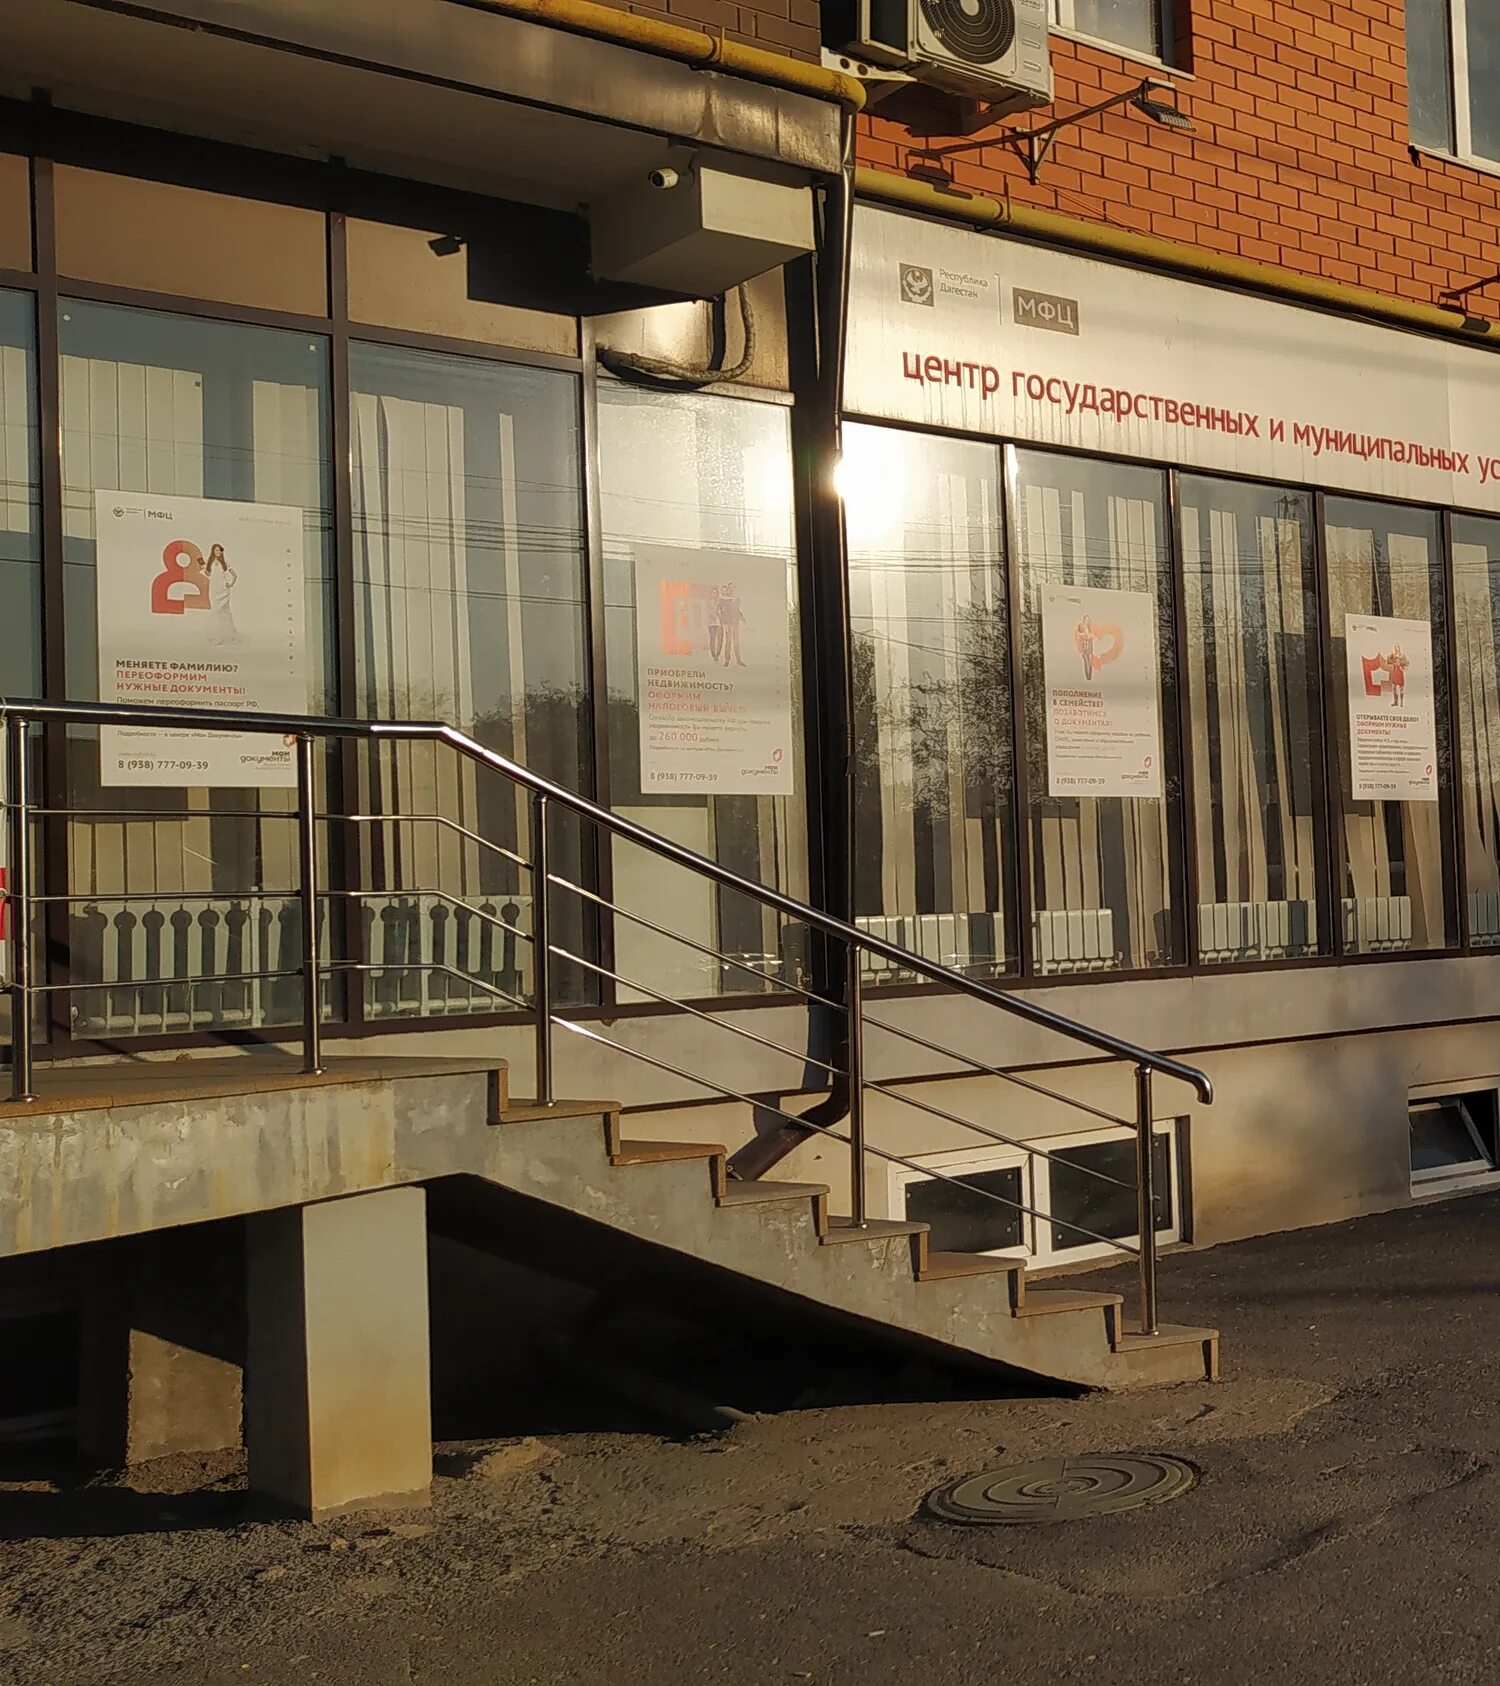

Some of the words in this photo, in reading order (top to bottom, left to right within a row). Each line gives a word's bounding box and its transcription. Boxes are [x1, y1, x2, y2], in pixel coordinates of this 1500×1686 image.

[939, 268, 989, 288] Республика
[939, 282, 978, 299] Дагестан
[1017, 295, 1074, 329] МФЦ
[902, 351, 999, 400] центр
[1012, 371, 1259, 438] государственных
[1269, 418, 1284, 442] и
[1293, 422, 1470, 474] муниципальных
[147, 510, 173, 521] МФЦ
[116, 660, 168, 670] МЕНЯЕТЕ
[170, 662, 239, 673] ФАМИЛИЮ?
[116, 670, 207, 681] ПЕРЕОФОРМИМ
[647, 668, 706, 679] ПРИОБРЕЛИ
[116, 682, 168, 692] НУЖНЫЕ
[170, 684, 246, 695] ДОКУМЕНТЫ!
[648, 679, 733, 691] НЕДВИЖИМОСТЬ?
[118, 760, 124, 769] 8
[127, 760, 154, 770] (938)
[157, 760, 209, 770] 777-09-39
